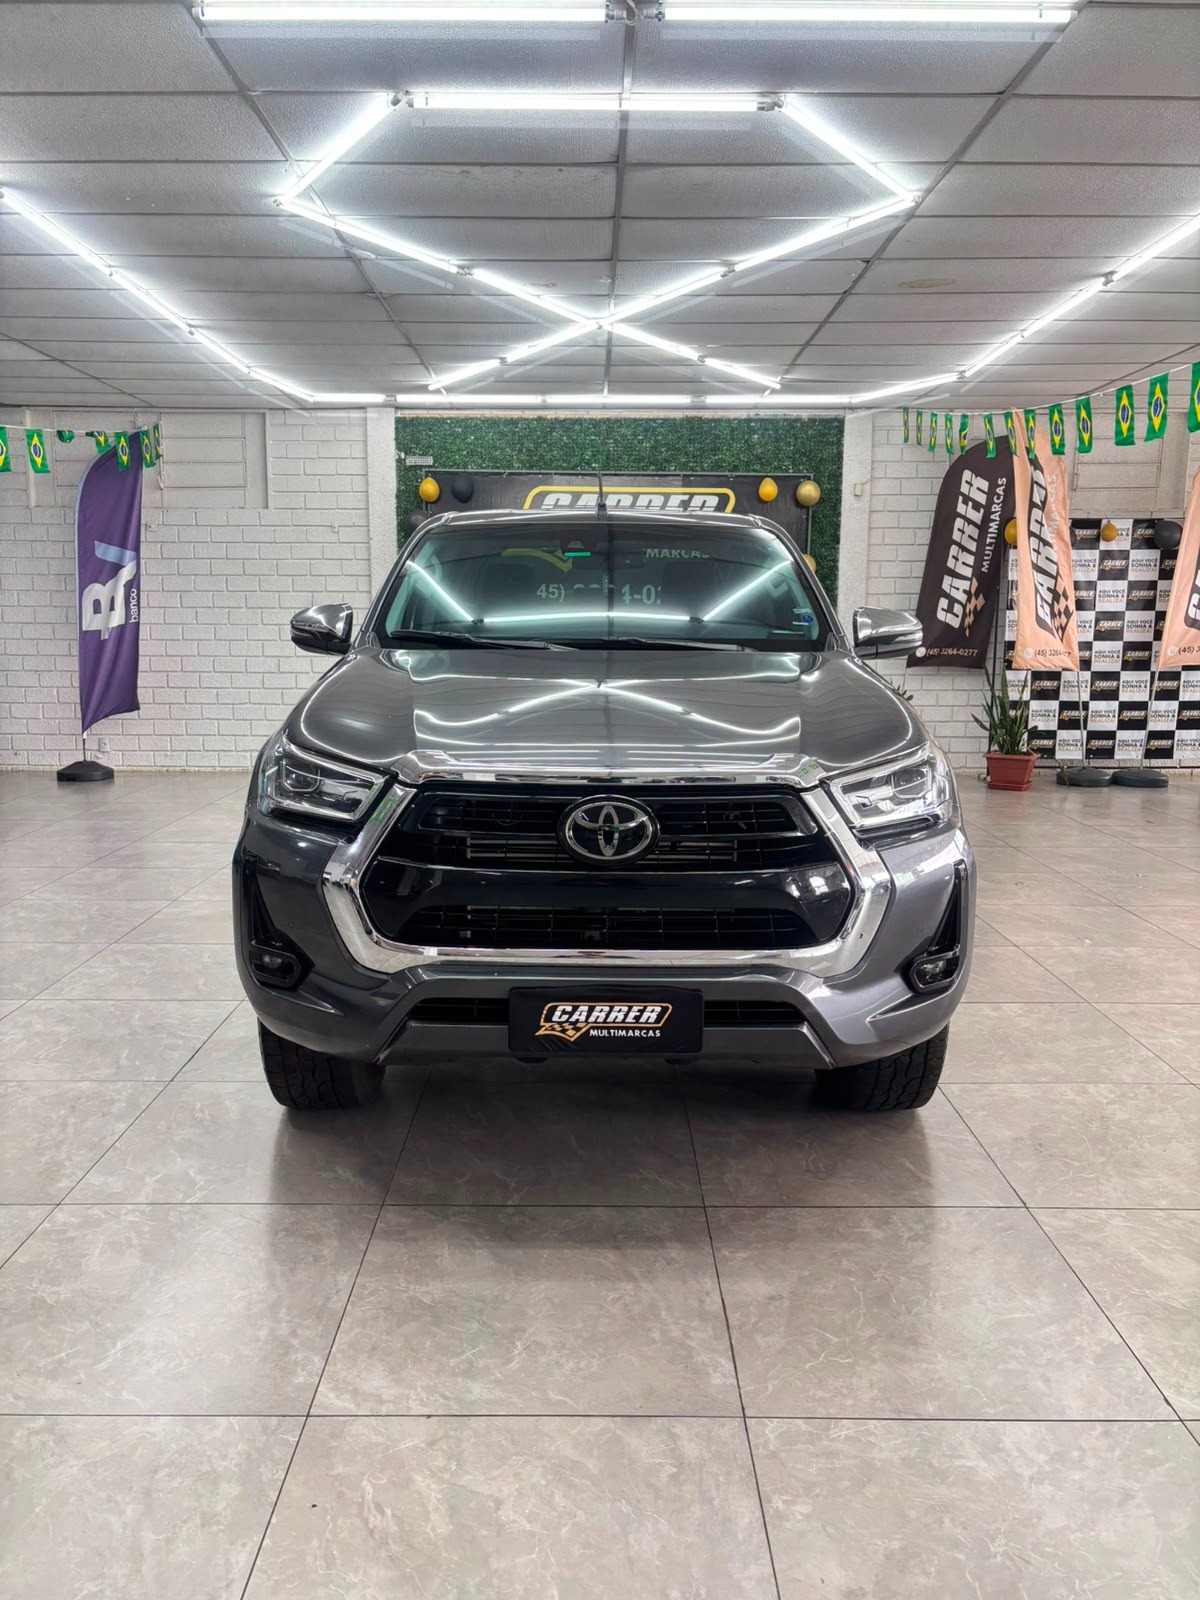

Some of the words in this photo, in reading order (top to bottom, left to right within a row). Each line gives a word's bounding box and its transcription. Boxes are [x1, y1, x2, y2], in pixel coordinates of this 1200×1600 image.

[981, 477, 1007, 573] MULTIMARCAS
[936, 469, 990, 629] CARRER
[129, 588, 138, 623] banco
[940, 648, 978, 656] 3264-0277
[1034, 649, 1047, 657] (45)
[1178, 646, 1194, 655] (45)
[551, 1005, 662, 1022] CARRER
[589, 1029, 661, 1037] MULTIMARCAS
